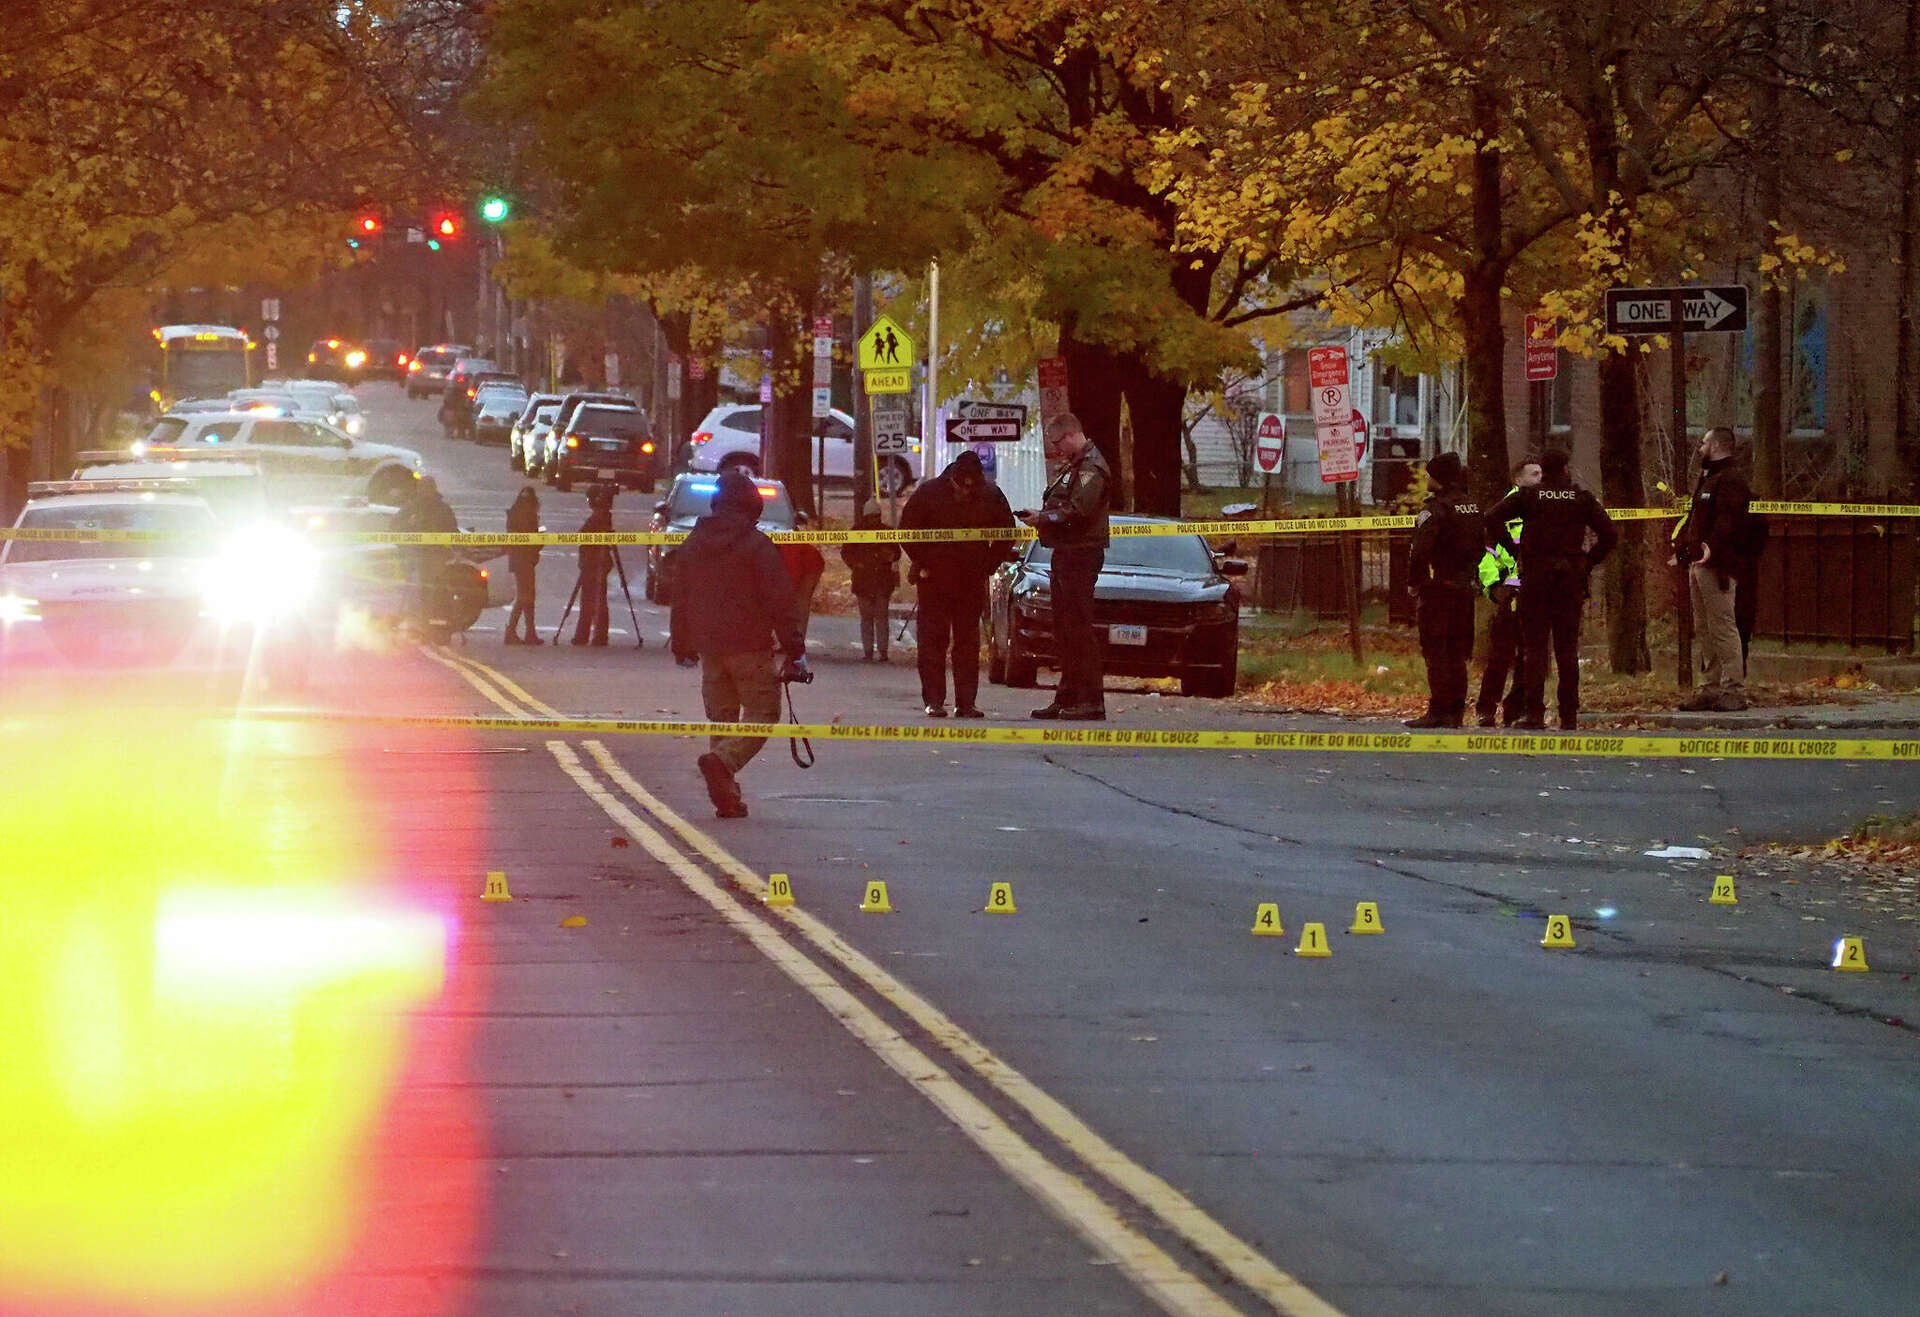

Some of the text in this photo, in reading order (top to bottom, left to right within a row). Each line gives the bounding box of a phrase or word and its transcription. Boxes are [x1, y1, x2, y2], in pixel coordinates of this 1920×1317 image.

[1629, 301, 1721, 320] ONE WAY
[1528, 352, 1555, 363] Anytime
[872, 376, 904, 388] AHEAD
[970, 407, 991, 418] ONE
[961, 425, 1008, 435] ONE WAY
[1262, 424, 1269, 434] DO
[876, 433, 905, 450] 25
[1539, 490, 1576, 500] POLICE
[1454, 503, 1479, 514] POLICE
[1757, 503, 1769, 512] LINE
[1770, 503, 1778, 512] DO
[1780, 504, 1791, 513] NOT
[1794, 504, 1812, 513] CROSS
[1841, 505, 1860, 513] POLICE
[1862, 506, 1875, 514] LINE
[1275, 519, 1347, 530] POLICE LINE DO NOT CROSS
[1373, 517, 1414, 526] POLICE LINE DO
[1112, 525, 1152, 534] DO NOT CROSS
[1177, 522, 1250, 533] POLICE LINE DO NOT CROSS
[450, 534, 530, 543] POLICE LINE DO NOT CROSS
[558, 534, 637, 543] POLICE LINE DO NOT CROSS
[771, 532, 849, 542] POLICE LINE DO NOT CROSS
[876, 531, 953, 540] POLICE LINE DO NOT CROSS
[981, 529, 1035, 539] POLICE LINE DO NOT
[489, 883, 502, 894] 11
[772, 881, 788, 895] 10
[1717, 886, 1730, 896] 12
[871, 889, 880, 903] 9
[995, 889, 1006, 905] 8
[1261, 910, 1272, 927] 4
[1364, 909, 1372, 923] 5
[1553, 922, 1564, 939] 3
[1310, 930, 1315, 948] 1
[1849, 945, 1857, 961] 2
